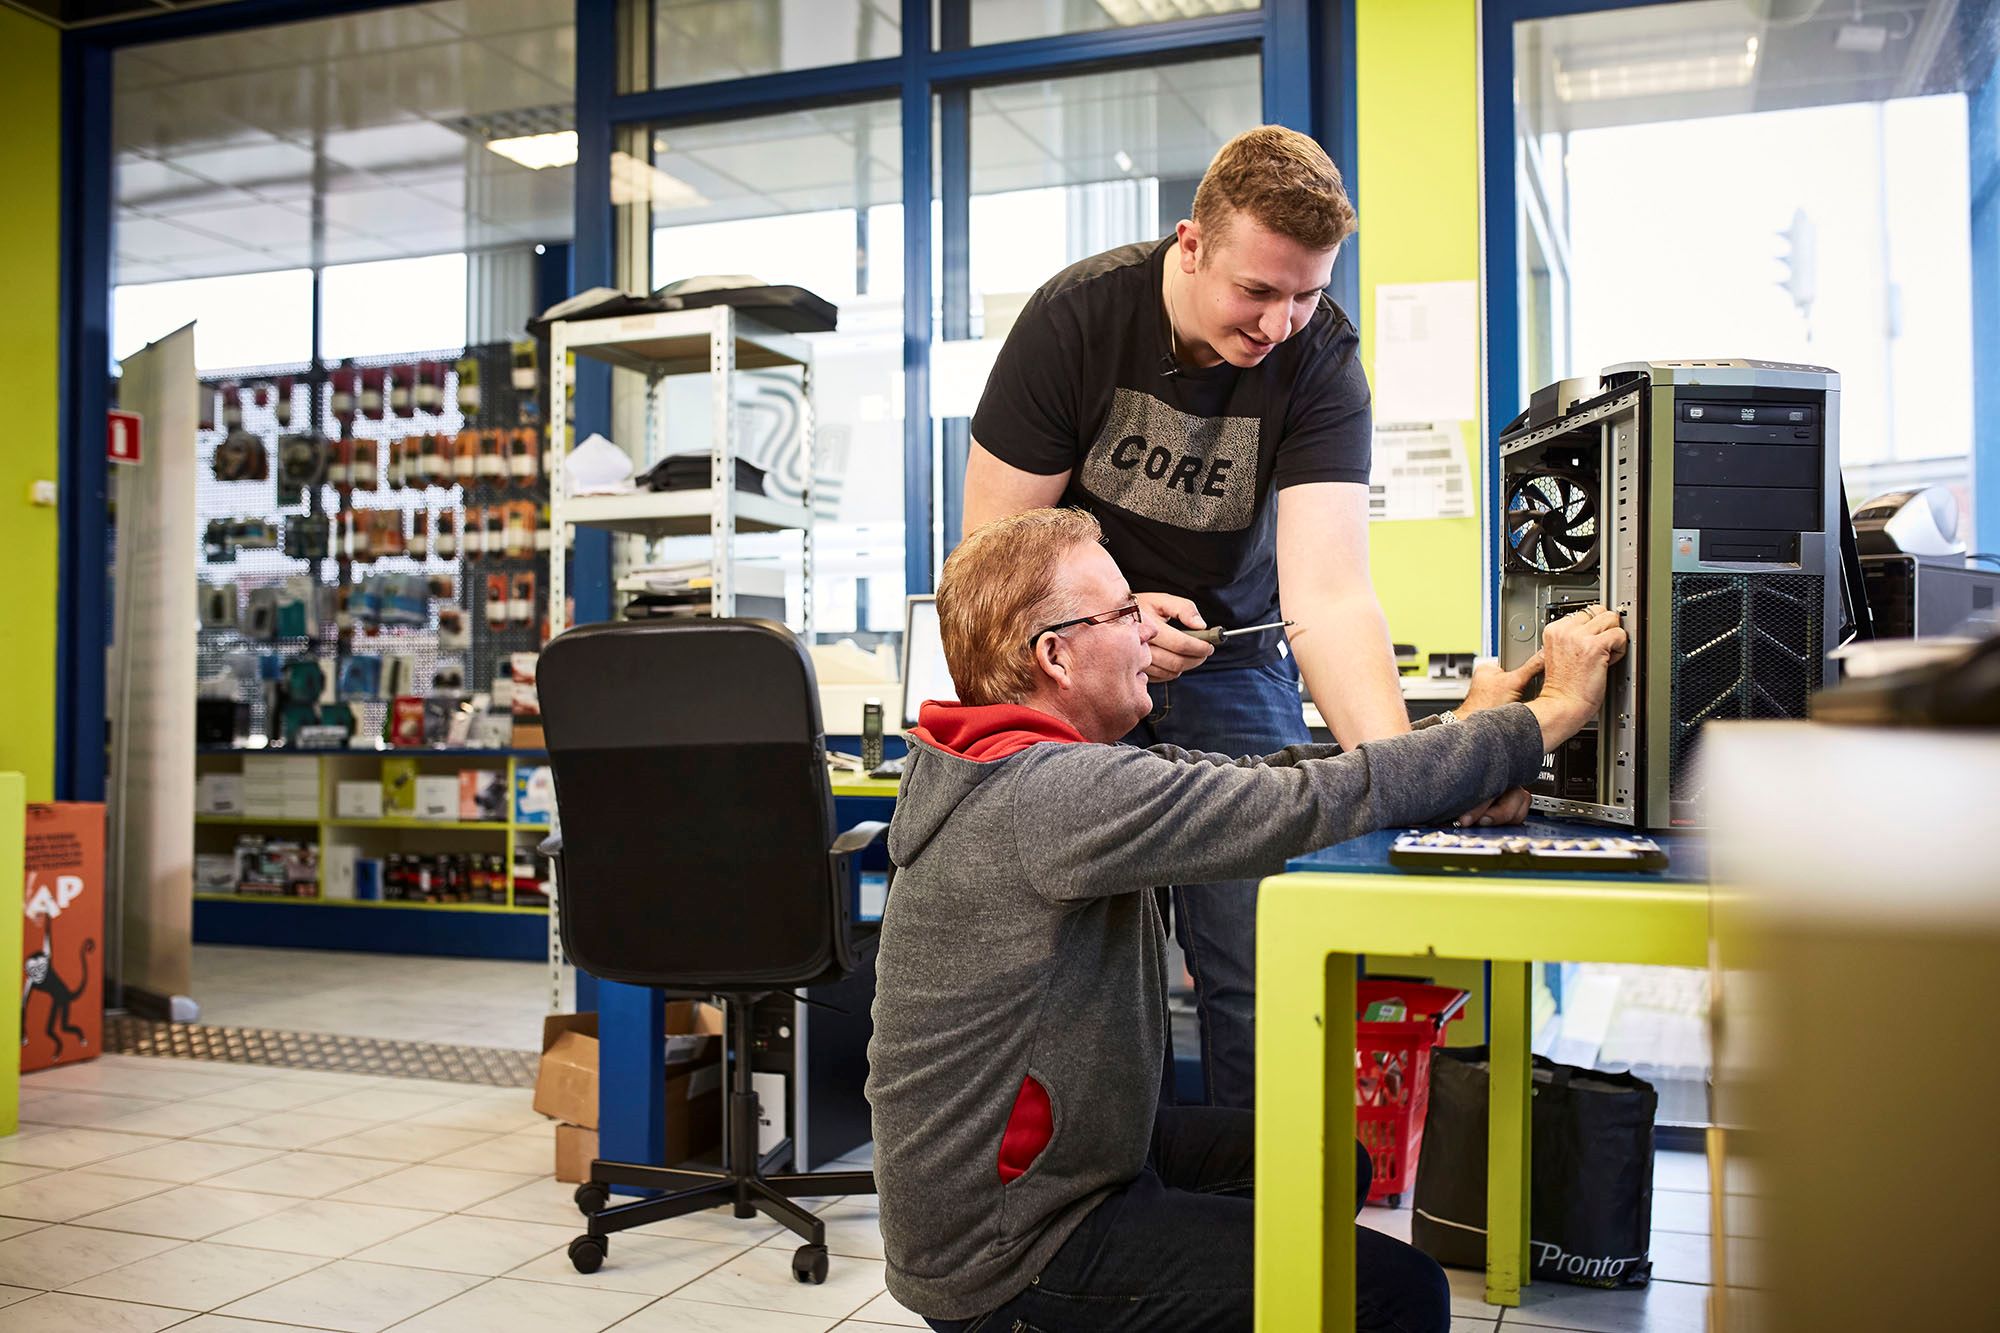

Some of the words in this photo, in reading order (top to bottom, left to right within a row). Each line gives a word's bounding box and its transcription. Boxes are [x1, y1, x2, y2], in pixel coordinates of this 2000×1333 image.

[1111, 435, 1233, 498] CORE
[25, 871, 84, 919] AP
[1531, 1240, 1640, 1278] Pronto
